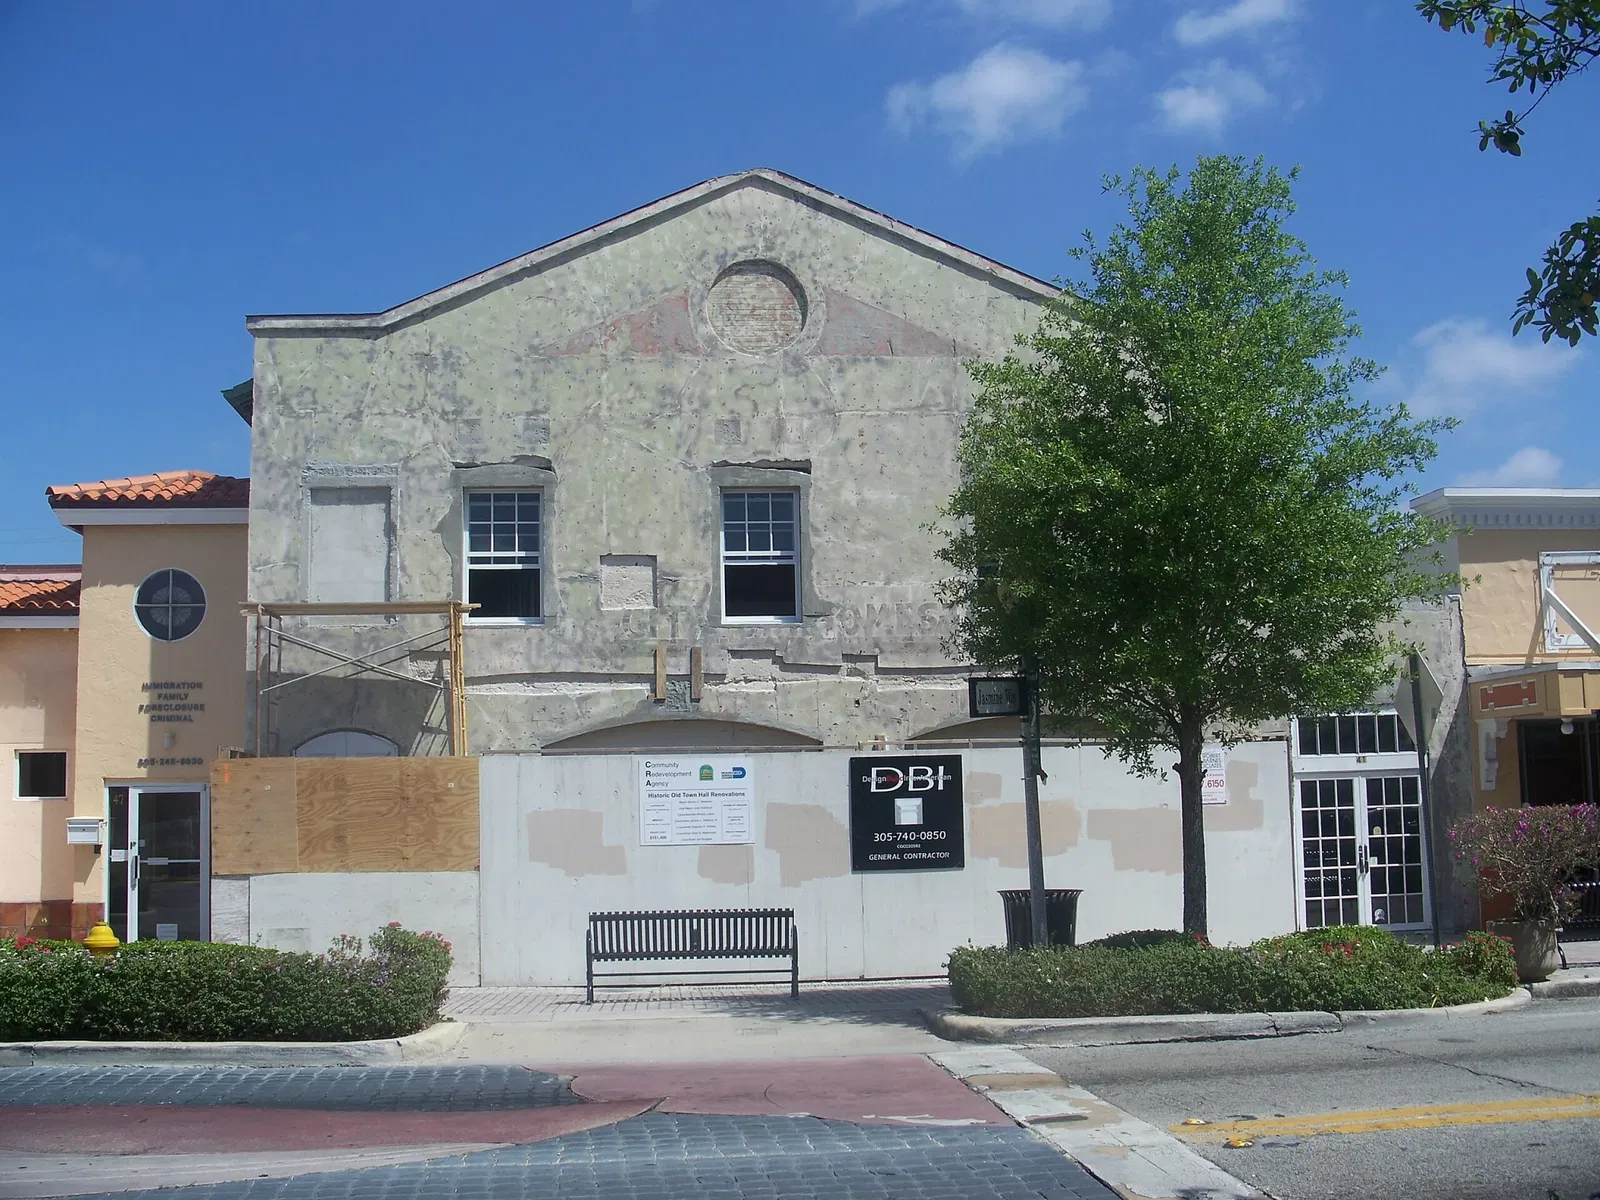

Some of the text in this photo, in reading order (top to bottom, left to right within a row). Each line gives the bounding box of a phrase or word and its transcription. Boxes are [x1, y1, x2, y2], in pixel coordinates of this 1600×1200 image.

[141, 682, 203, 690] IMMIGRATION
[138, 704, 205, 712] FORECLOSURE
[645, 761, 679, 769] Community
[645, 770, 692, 778] Redevelopment
[870, 765, 944, 793] DBI
[113, 794, 124, 805] 47
[873, 830, 947, 842] 305-740-0850
[868, 851, 950, 861] GENERAL CONTRACTOR
